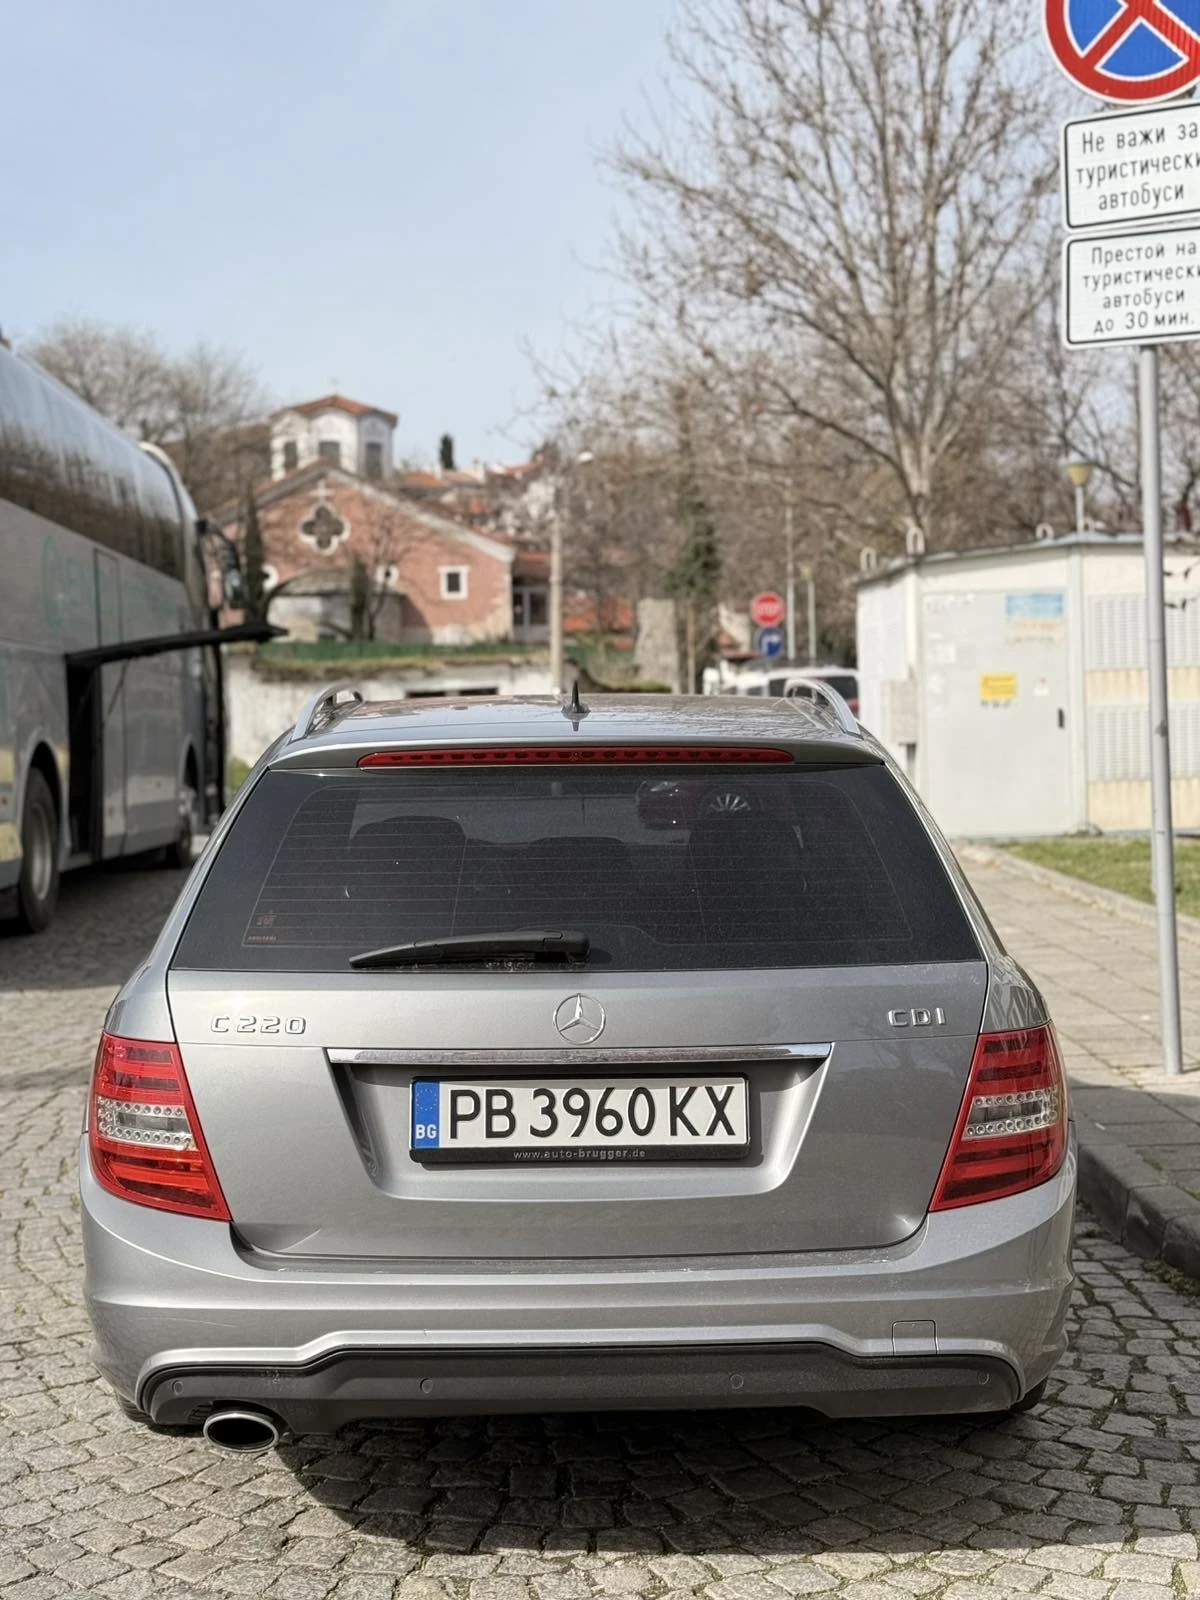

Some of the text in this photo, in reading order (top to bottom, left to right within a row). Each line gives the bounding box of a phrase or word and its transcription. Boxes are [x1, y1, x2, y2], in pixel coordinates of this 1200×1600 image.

[1082, 122, 1198, 154] Не важи за
[1098, 182, 1184, 211] автобуси
[1091, 241, 1197, 268] Престой на
[1103, 287, 1185, 309] автобуси
[1093, 311, 1195, 334] до 30 мин.
[210, 1015, 306, 1035] C 220
[888, 1007, 946, 1027] CDI
[449, 1085, 736, 1139] PB 3960 KX
[415, 1124, 437, 1139] BG
[513, 1148, 646, 1160] www.auto-brugger.de
